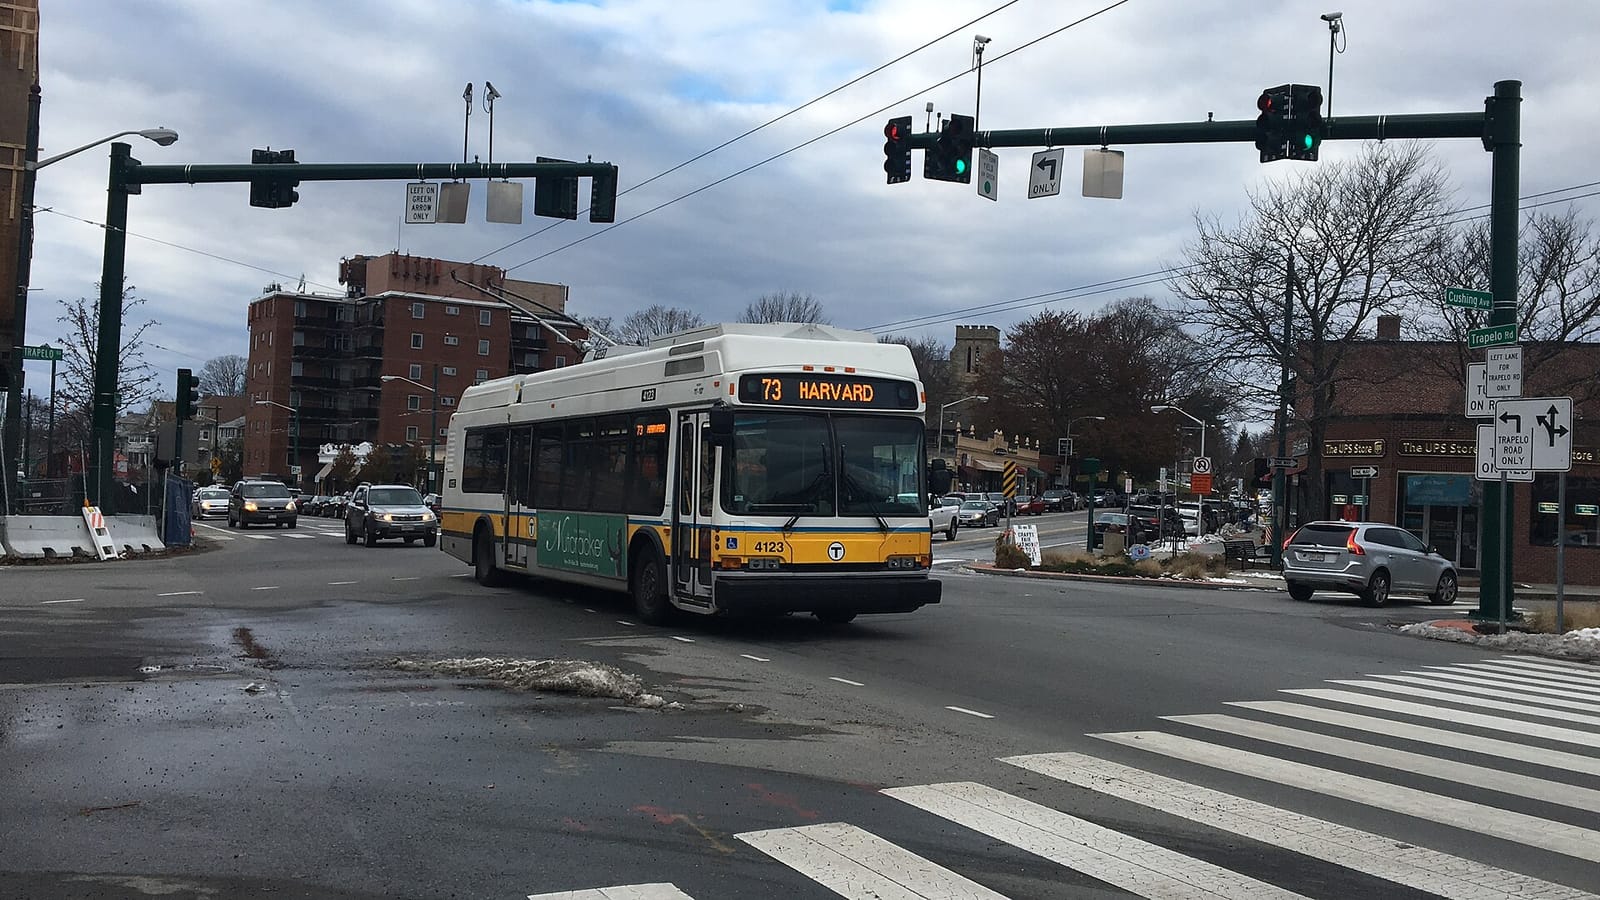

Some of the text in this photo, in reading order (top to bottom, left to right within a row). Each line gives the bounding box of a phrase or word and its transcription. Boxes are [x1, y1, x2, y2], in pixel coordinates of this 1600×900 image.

[1033, 182, 1056, 194] ONLY
[412, 195, 432, 203] GREEN
[413, 212, 429, 220] ONLY
[1448, 291, 1490, 307] Cushing Ave
[1471, 330, 1514, 346] Trapelo Rd
[24, 348, 54, 358] TRAPELO
[762, 379, 874, 402] 73 HARVARD
[1470, 400, 1484, 410] ON
[636, 424, 644, 436] 73
[1498, 436, 1529, 444] TRAPELO
[1325, 444, 1337, 454] The
[1338, 444, 1352, 454] UPS
[1353, 443, 1372, 454] Store
[1403, 442, 1422, 453] The
[1425, 443, 1447, 453] UPS
[1504, 446, 1523, 454] ROAD
[754, 542, 784, 552] 4123
[831, 546, 842, 558] T
